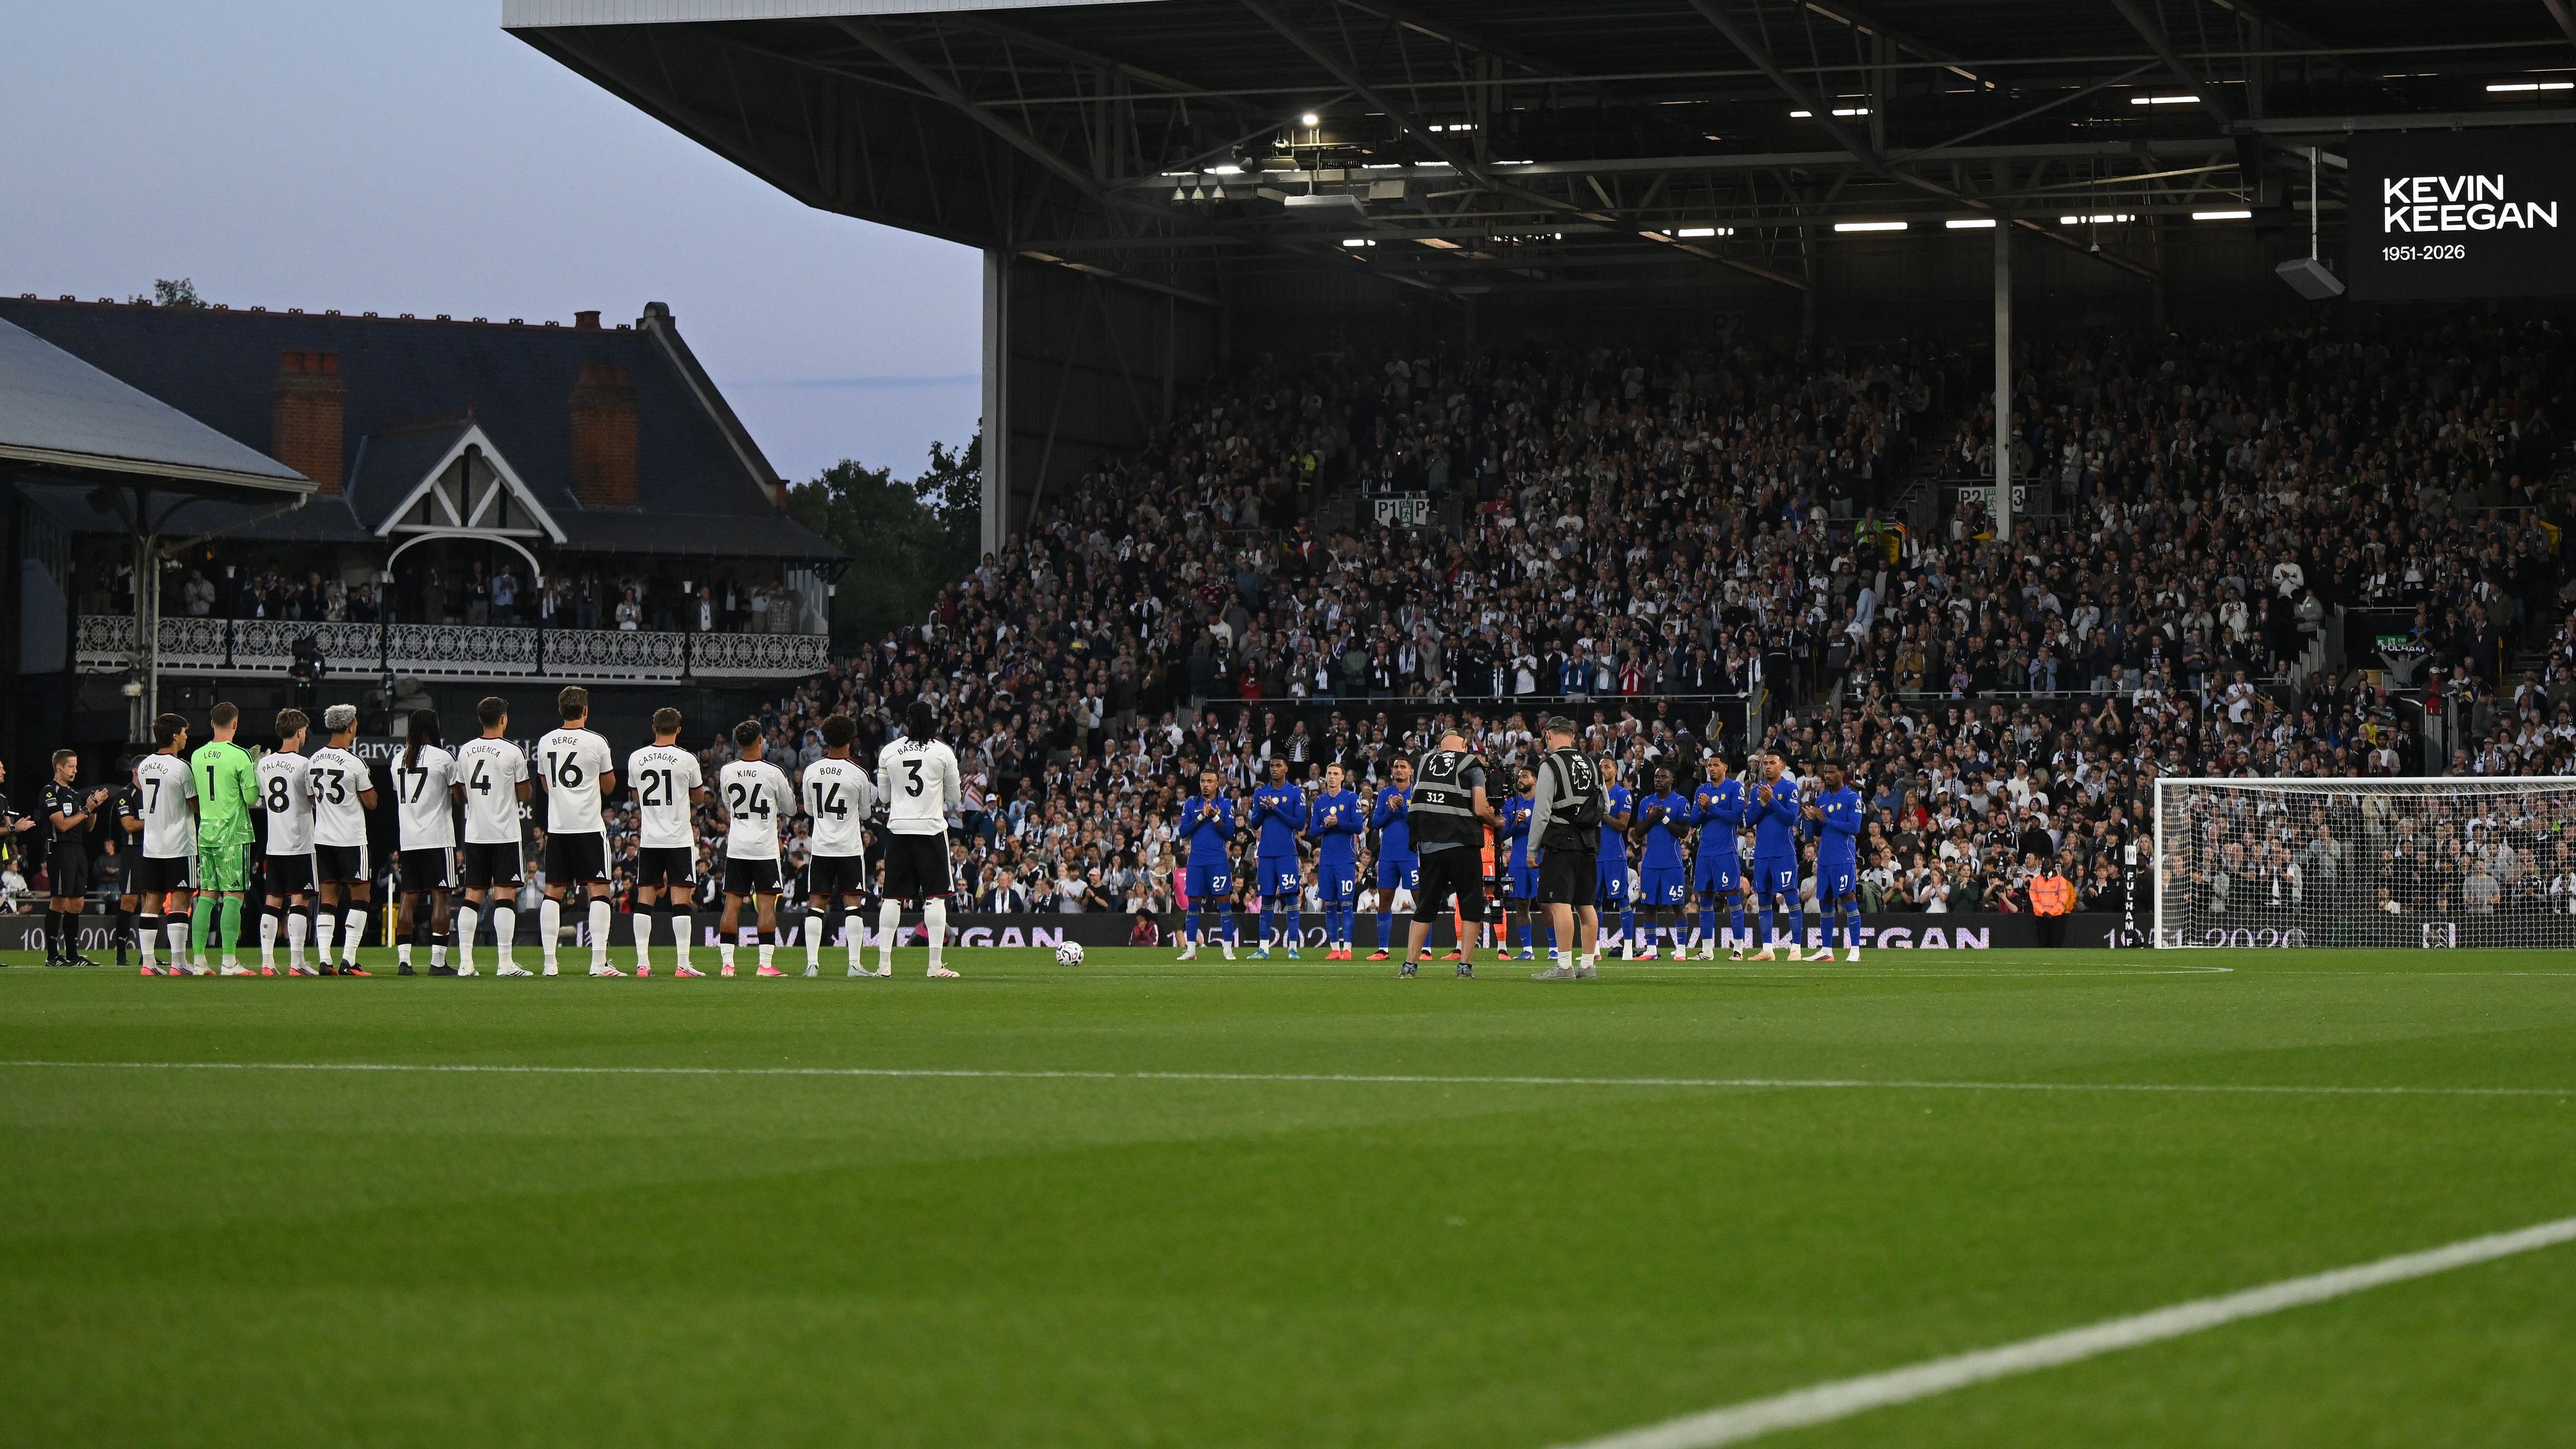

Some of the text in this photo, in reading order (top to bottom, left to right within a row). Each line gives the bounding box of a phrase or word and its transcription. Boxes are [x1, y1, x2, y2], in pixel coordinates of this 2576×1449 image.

[2384, 174, 2504, 205] KEVIN
[2384, 201, 2558, 234] KEEGAN
[2382, 245, 2466, 261] 1951-2026
[1378, 501, 1396, 519] P1
[351, 736, 405, 759] arve
[552, 736, 579, 746] BERGE
[897, 744, 930, 755] BASSEY
[203, 750, 221, 759] LENO
[312, 753, 346, 766] ROBINSON
[638, 753, 678, 766] CASTAGNE
[140, 762, 169, 775] GONZALO
[262, 761, 295, 773] PALACIOS
[547, 752, 583, 788] 16
[737, 770, 757, 778] KING
[819, 767, 842, 776] BOBB
[206, 765, 215, 801] 1
[397, 767, 429, 804] 17
[470, 759, 492, 796] 4
[902, 759, 924, 797] 3
[268, 776, 290, 813] 8
[310, 768, 346, 805] 33
[640, 769, 672, 806] 21
[145, 778, 160, 814] 7
[728, 782, 770, 820] 24
[812, 782, 848, 820] 14
[1426, 792, 1445, 804] 312
[1212, 876, 1227, 889] 27
[1281, 874, 1297, 887] 34
[1411, 870, 1420, 882] 5
[1721, 872, 1728, 884] 6
[1781, 871, 1792, 883] 17
[1341, 880, 1353, 892] 10
[1611, 879, 1620, 892] 9
[1669, 885, 1683, 898] 45
[2125, 872, 2134, 930] FULHAM
[862, 926, 1063, 948] KEGAN
[1167, 927, 1345, 948] 151-202
[1600, 927, 1990, 949] KEVN KEEGAN
